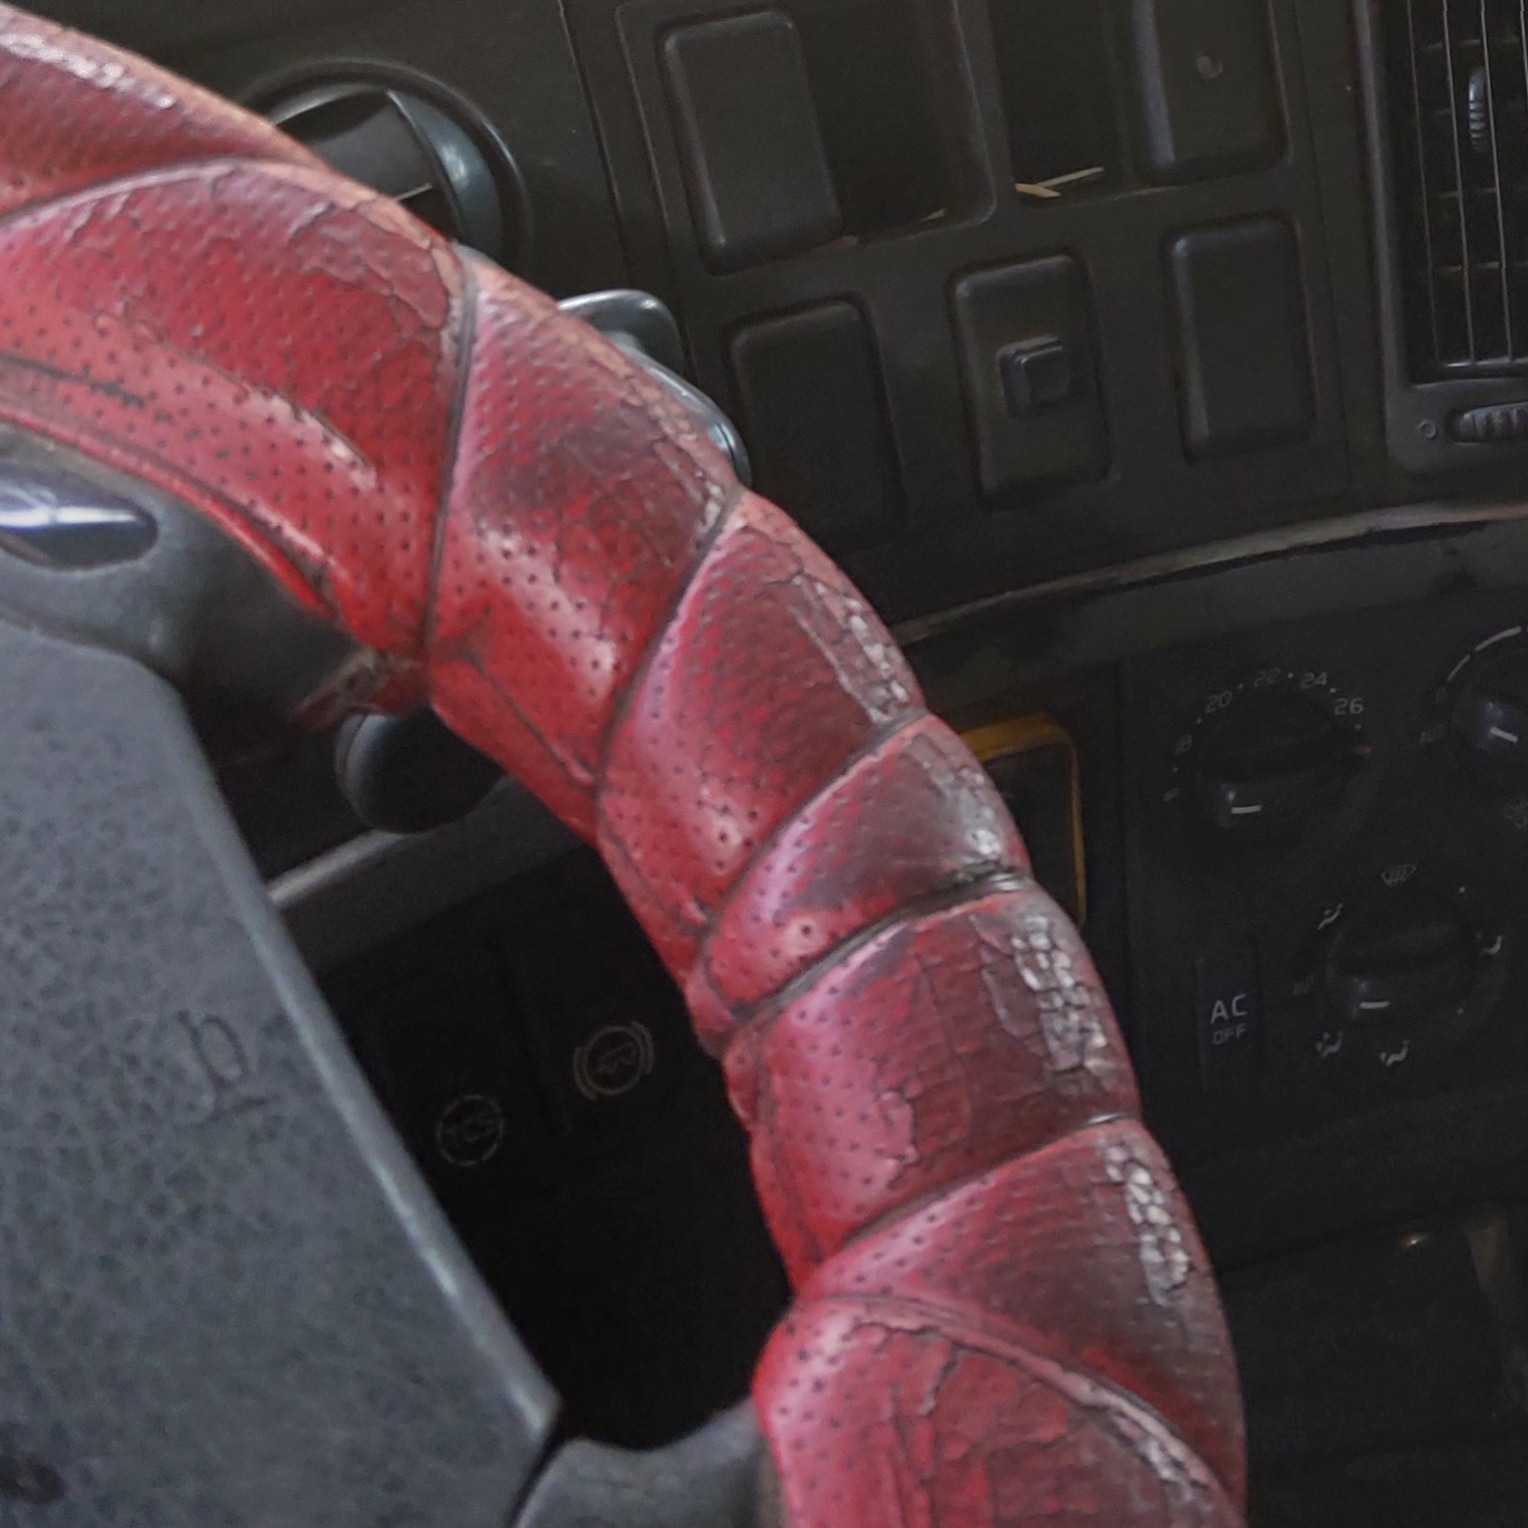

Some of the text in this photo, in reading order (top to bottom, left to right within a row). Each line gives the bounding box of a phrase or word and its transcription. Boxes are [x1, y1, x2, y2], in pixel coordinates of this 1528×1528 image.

[1300, 671, 1328, 689] 24
[1204, 690, 1233, 715] 20
[1333, 697, 1364, 716] 26
[1209, 992, 1248, 1025] AC
[1211, 1022, 1247, 1047] OFF
